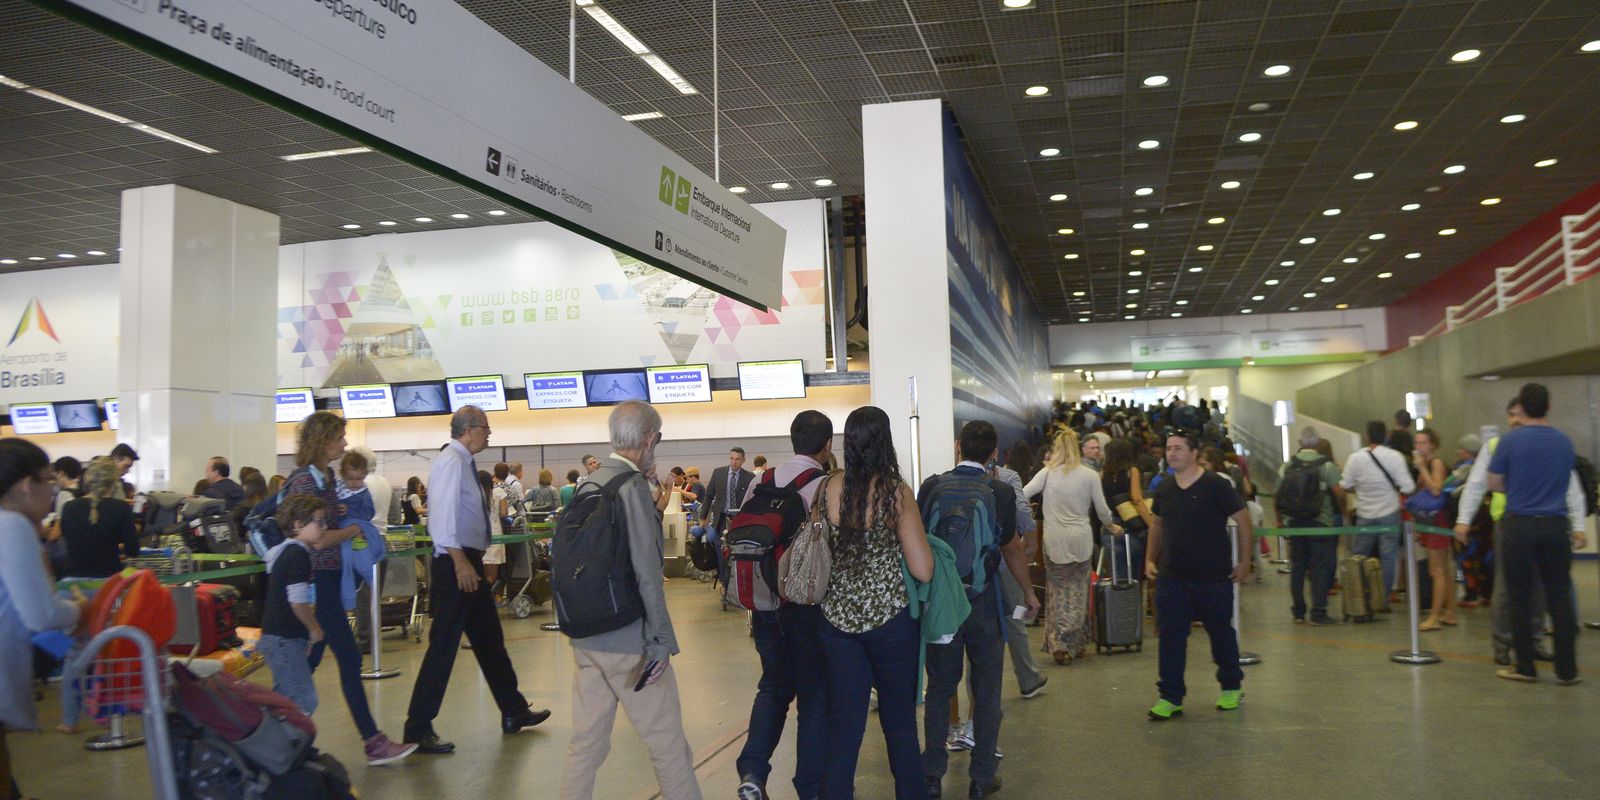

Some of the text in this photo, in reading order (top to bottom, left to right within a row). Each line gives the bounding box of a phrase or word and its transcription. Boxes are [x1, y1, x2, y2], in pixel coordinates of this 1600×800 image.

[315, 0, 386, 39] eparture
[157, 0, 396, 123] Praça de alimentação Food court
[520, 168, 593, 213] Sanitários Restrooms
[693, 186, 752, 233] Embarque Internacional
[691, 205, 740, 244] International Departure
[461, 287, 580, 308] www.bsb.aero
[1, 368, 66, 388] Brasília
